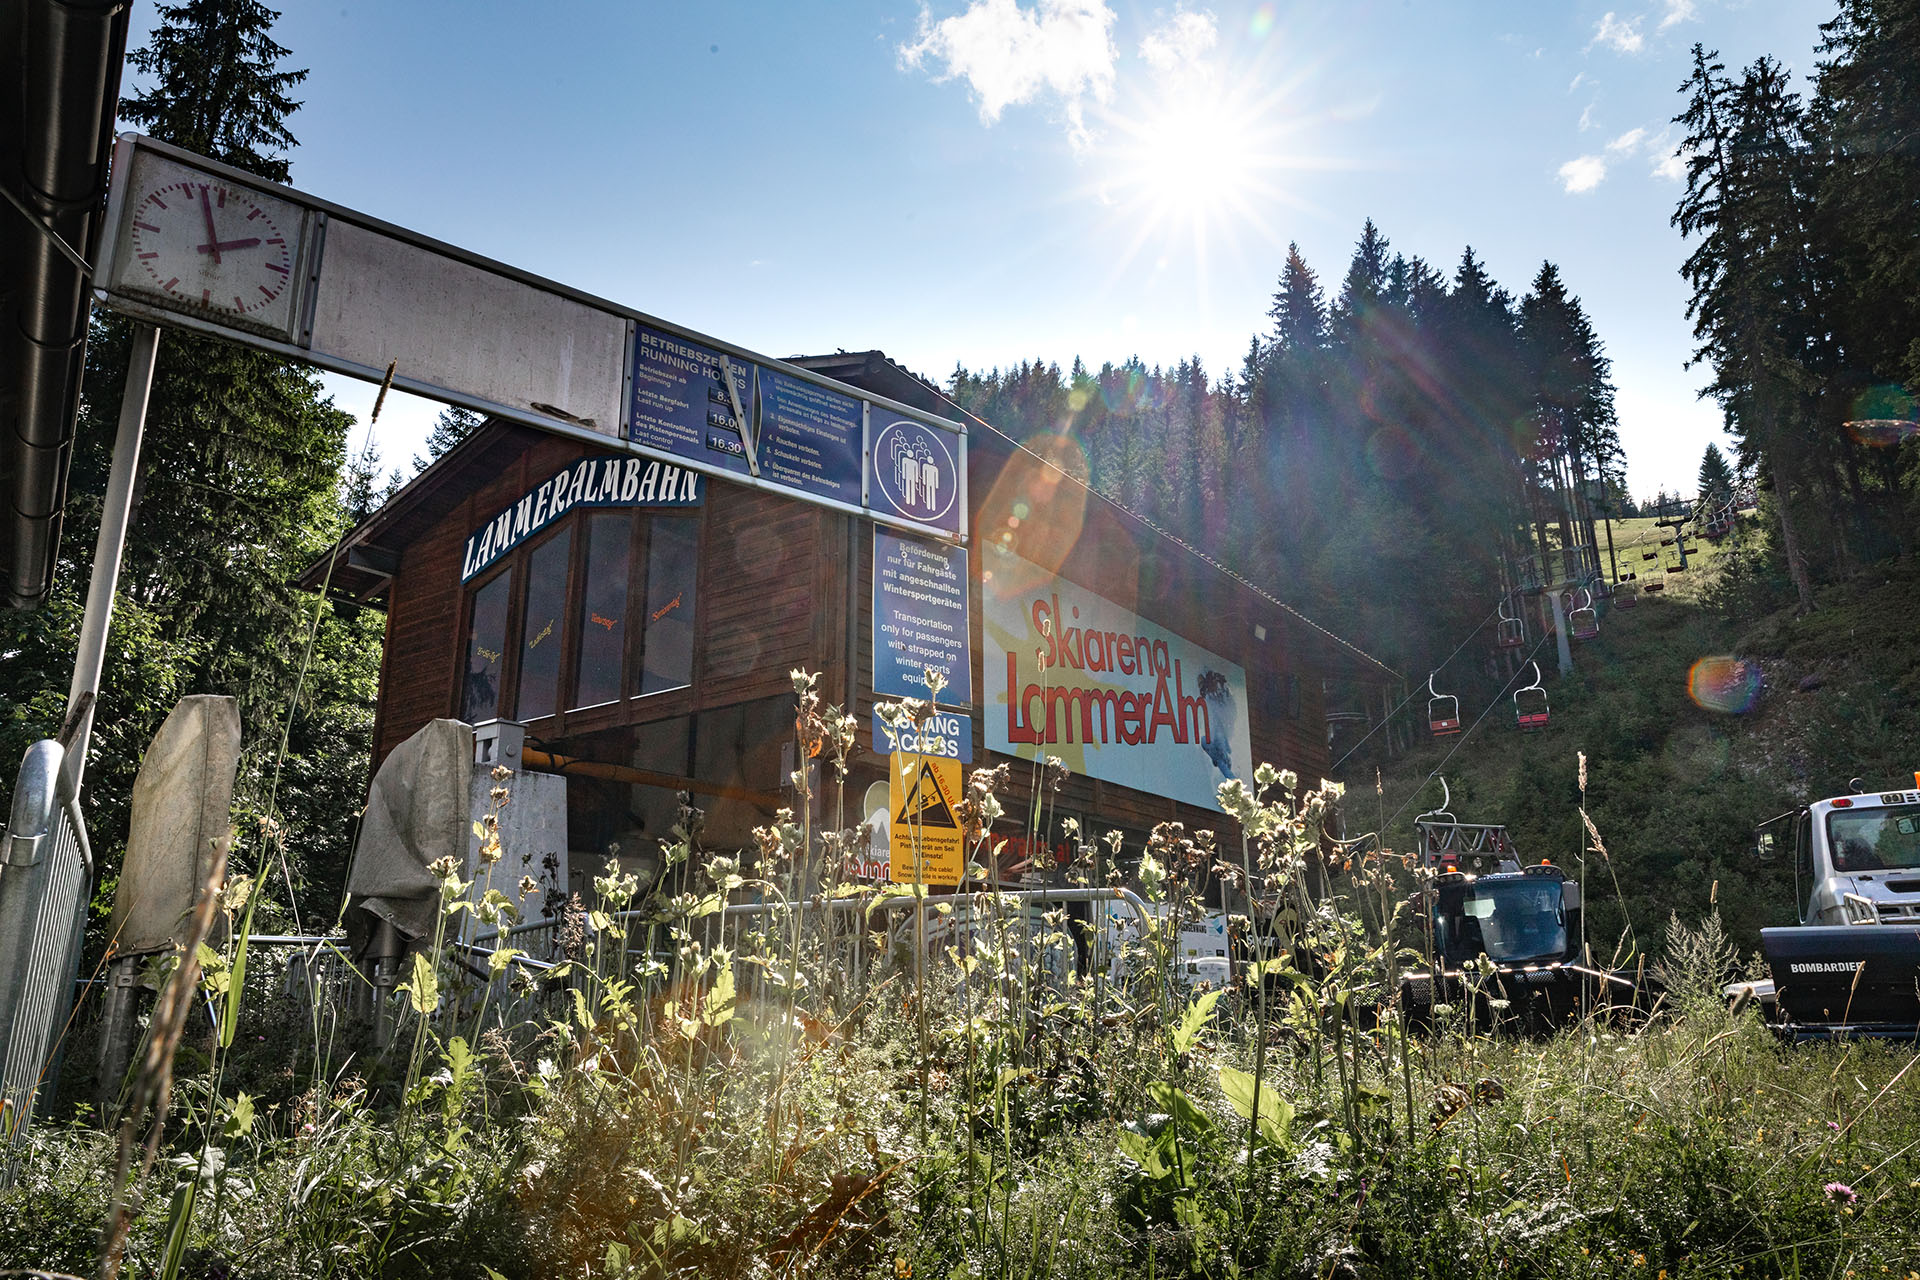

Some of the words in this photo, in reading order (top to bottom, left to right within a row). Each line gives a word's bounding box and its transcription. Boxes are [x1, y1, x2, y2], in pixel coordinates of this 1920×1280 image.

[640, 346, 699, 374] RUNNING
[639, 363, 678, 381] Betriebszeit
[678, 375, 687, 384] ab
[639, 371, 671, 388] Beginning
[637, 395, 652, 406] Last
[652, 400, 664, 409] run
[638, 387, 659, 399] Letzte
[659, 394, 689, 409] Bergfahrt
[635, 421, 648, 429] des
[648, 424, 700, 444] Pistenpersonals
[636, 411, 657, 424] Letzte
[658, 419, 698, 436] Kontrollfahrt
[635, 429, 650, 439] Last
[650, 434, 673, 445] control
[712, 436, 742, 454] 16.30
[462, 458, 699, 581] LAMMERALMBAHN
[899, 542, 949, 565] Beförderung
[887, 555, 902, 565] nur
[903, 557, 916, 569] für
[917, 562, 957, 580] Fahrgäste
[882, 568, 898, 579] mit
[899, 573, 961, 596] angeschnallten
[882, 582, 962, 610] Wintersportgeräten
[893, 609, 953, 632] Transportation
[880, 624, 900, 636] only
[901, 626, 914, 637] for
[915, 631, 962, 649] passengers
[1032, 593, 1171, 679] Skiarena
[887, 640, 906, 651] with
[908, 644, 945, 659] strapped
[946, 653, 957, 662] on
[895, 656, 922, 668] winter
[924, 662, 951, 675] sports
[1007, 652, 1211, 746] LammerAlm
[888, 733, 960, 758] ACCESS
[931, 762, 940, 774] ab
[937, 774, 951, 796] 16.30
[900, 842, 933, 850] Pistnerät
